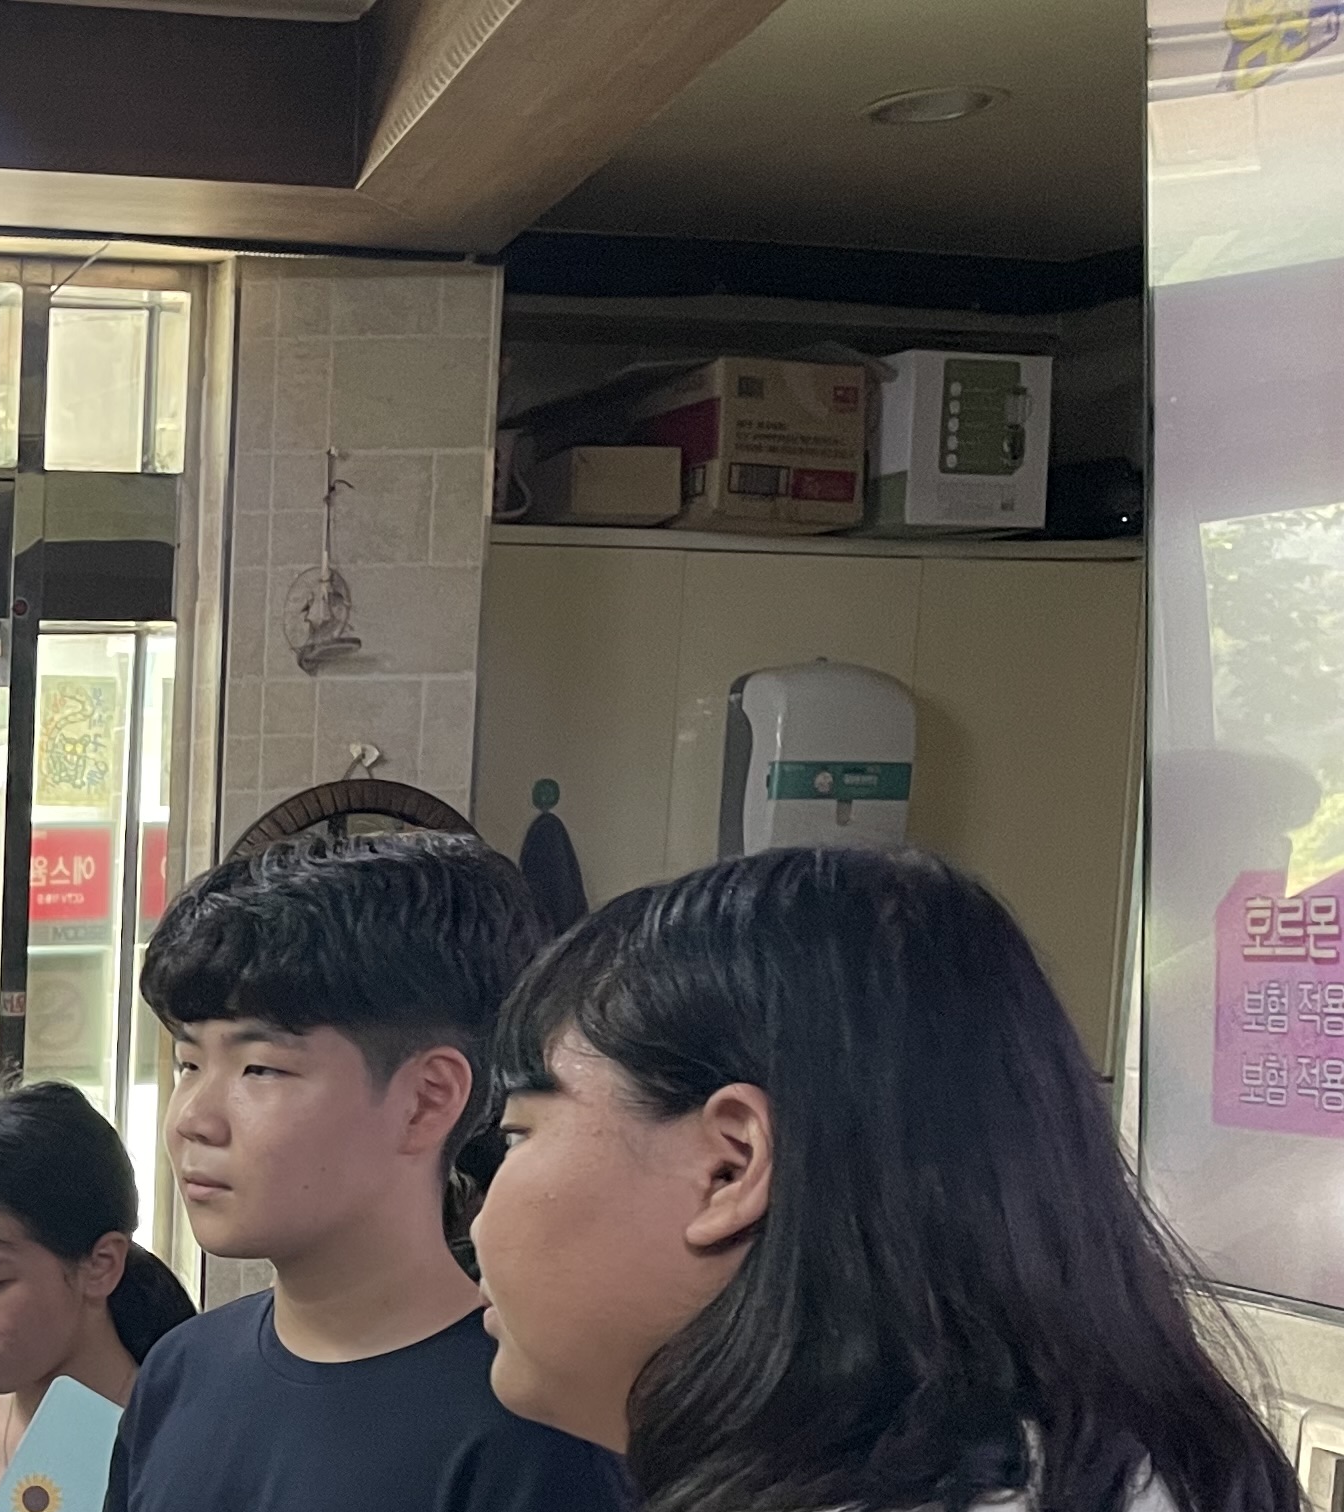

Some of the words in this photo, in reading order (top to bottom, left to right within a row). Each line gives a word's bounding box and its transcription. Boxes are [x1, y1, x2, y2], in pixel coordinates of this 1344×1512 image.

[1242, 896, 1342, 963] 호르몬
[1242, 980, 1289, 1034] 보험
[1239, 1053, 1288, 1107] 보험
